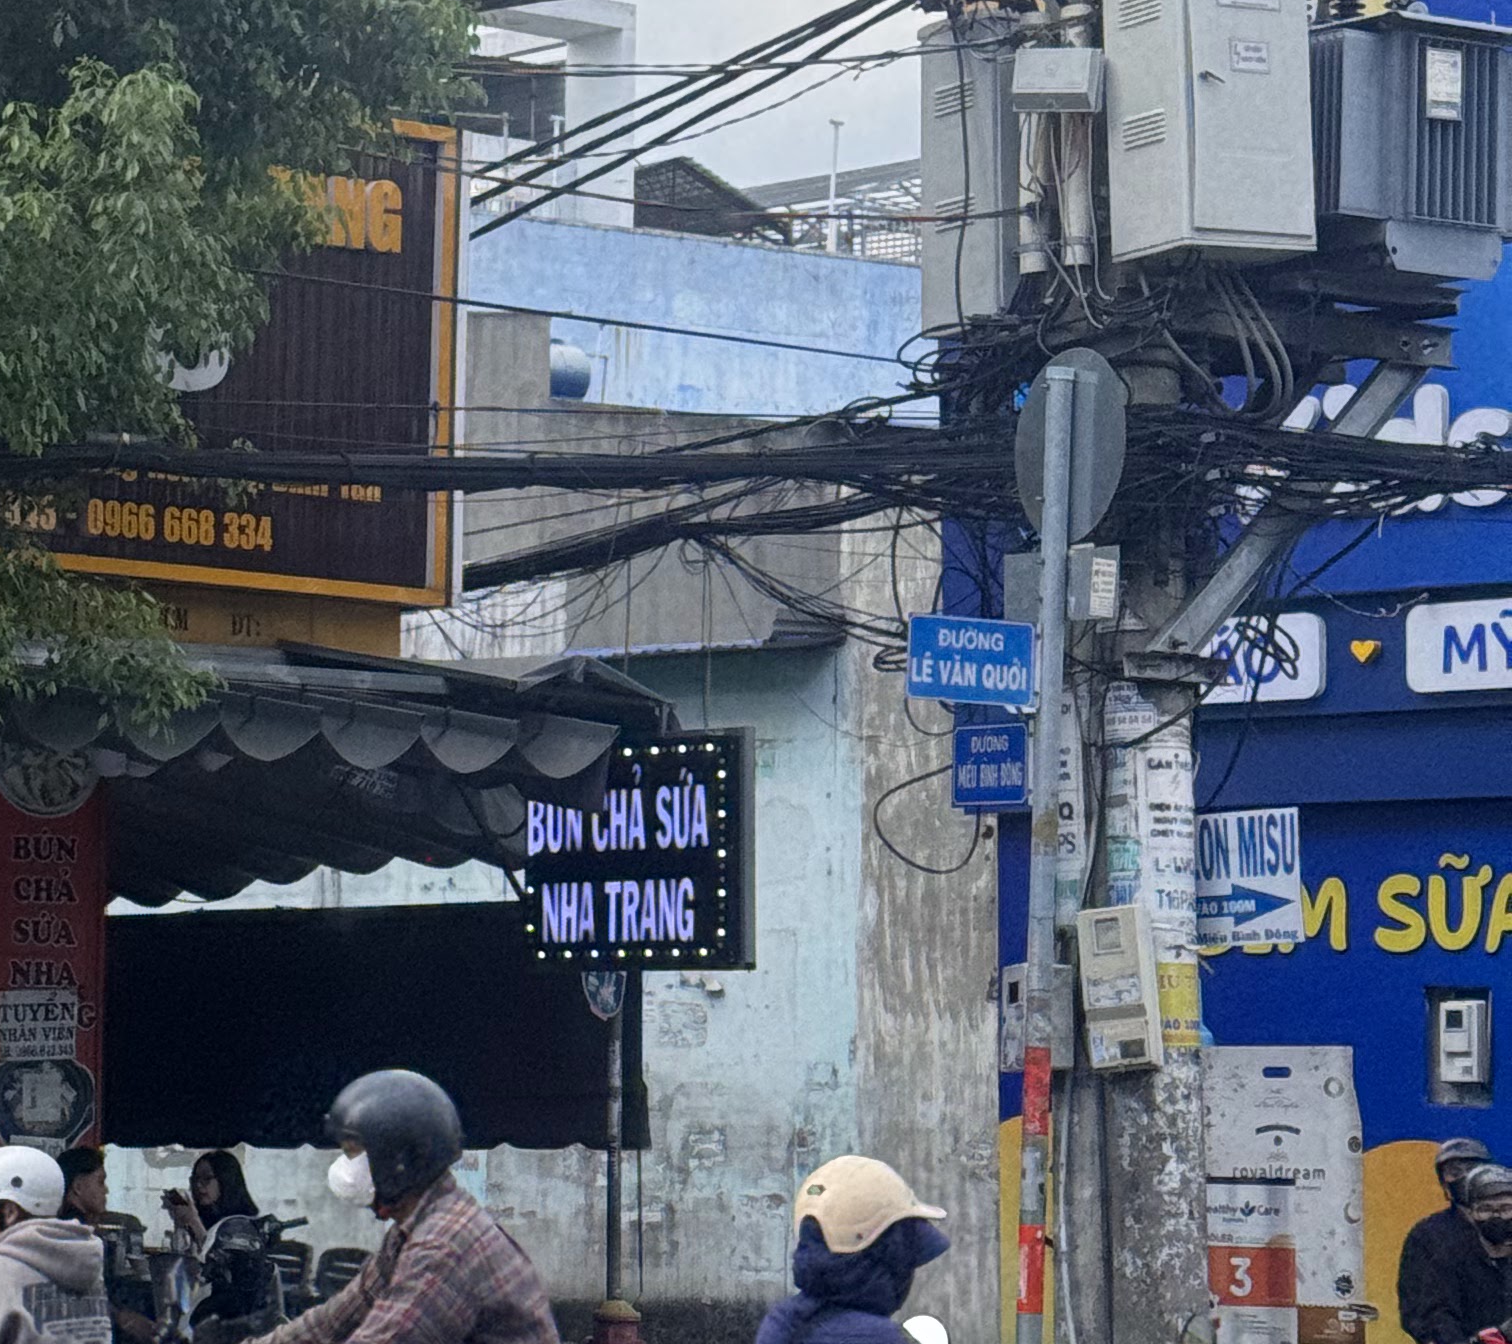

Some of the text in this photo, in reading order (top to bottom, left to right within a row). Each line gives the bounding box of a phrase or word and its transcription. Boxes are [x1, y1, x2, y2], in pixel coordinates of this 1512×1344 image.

[88, 498, 155, 540] 0966
[163, 506, 215, 546] 668
[223, 511, 273, 552] 334
[938, 627, 1004, 652] ĐƯỜNG
[911, 651, 934, 683] LÊ
[939, 656, 977, 687] VĂN
[591, 764, 646, 853] CHẢ
[11, 828, 77, 862] BÚN
[1195, 813, 1295, 881] ON MISU
[12, 867, 78, 904] CHẢ
[541, 877, 695, 943] NHA TRANG
[9, 959, 79, 988] NHA
[0, 991, 76, 1023] TUYỂN
[0, 1024, 74, 1042] NHÂN VIÊN
[1229, 1257, 1252, 1297] 3
